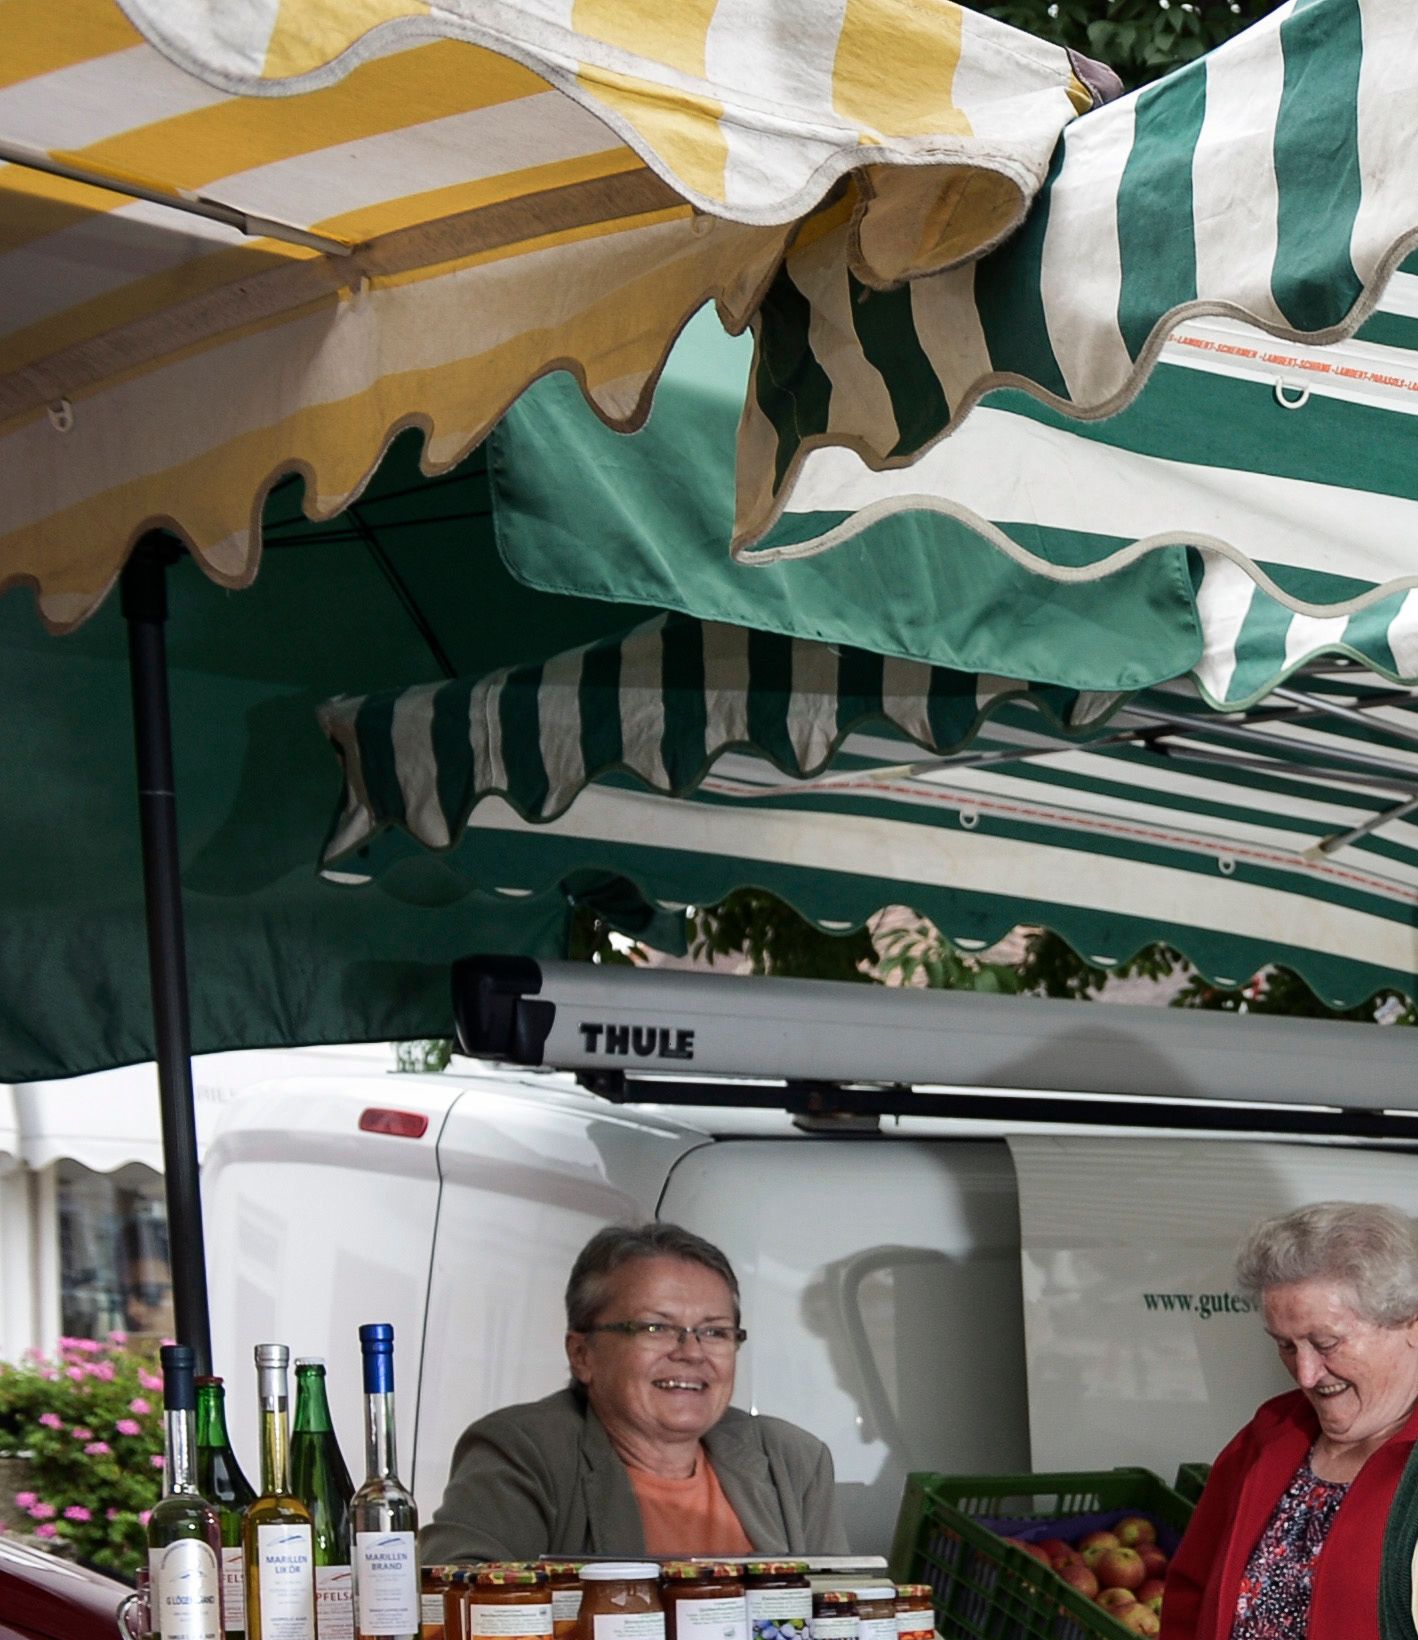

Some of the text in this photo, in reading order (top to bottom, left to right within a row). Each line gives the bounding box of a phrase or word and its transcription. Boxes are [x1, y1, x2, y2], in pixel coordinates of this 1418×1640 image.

[580, 1023, 694, 1060] THULE
[365, 1553, 408, 1561] MARILLEN
[371, 1562, 402, 1571] BRAND
